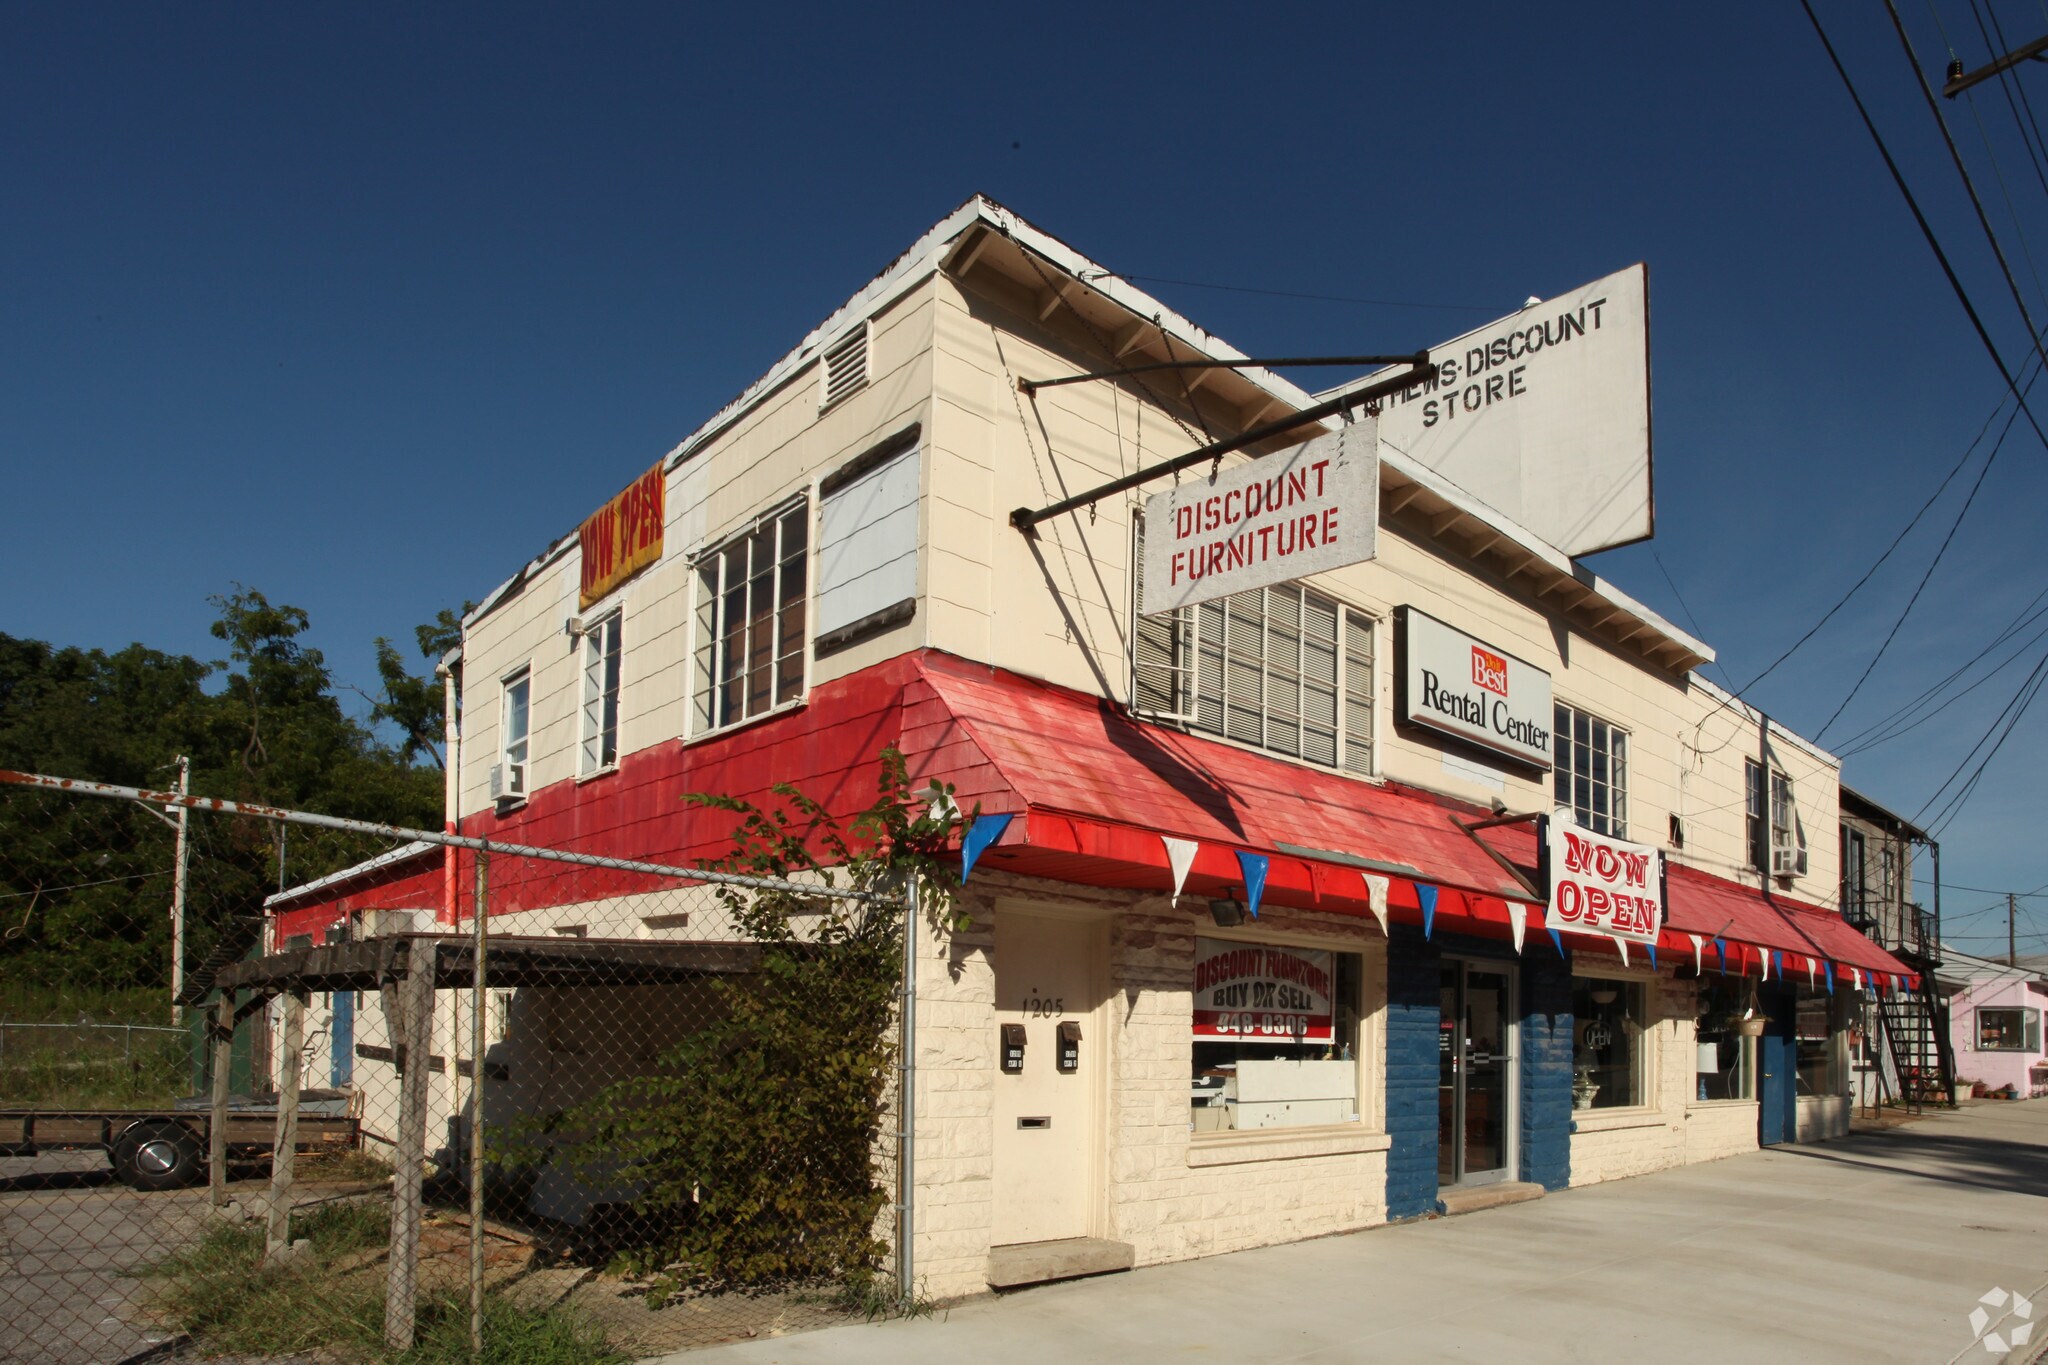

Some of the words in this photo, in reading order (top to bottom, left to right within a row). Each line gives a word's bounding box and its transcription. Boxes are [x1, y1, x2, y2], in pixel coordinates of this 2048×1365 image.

[1466, 297, 1607, 378] DISCOUNT
[1423, 365, 1527, 428] STORE
[1176, 459, 1329, 540] DISCOUNT
[1170, 507, 1339, 586] FURNITURE
[1473, 652, 1506, 693] Best
[1421, 668, 1487, 729] Rental
[1493, 700, 1549, 753] Center
[1563, 831, 1649, 888] NOW
[1557, 880, 1656, 934] OPEN
[1196, 949, 1264, 994] DISCOUNT
[1265, 950, 1329, 1001] FURNITURE
[1213, 982, 1249, 1007] BUY
[1253, 981, 1276, 1008] OR
[1278, 984, 1313, 1010] SELL
[1022, 998, 1064, 1019] 1205
[1586, 1030, 1611, 1046] OPEN
